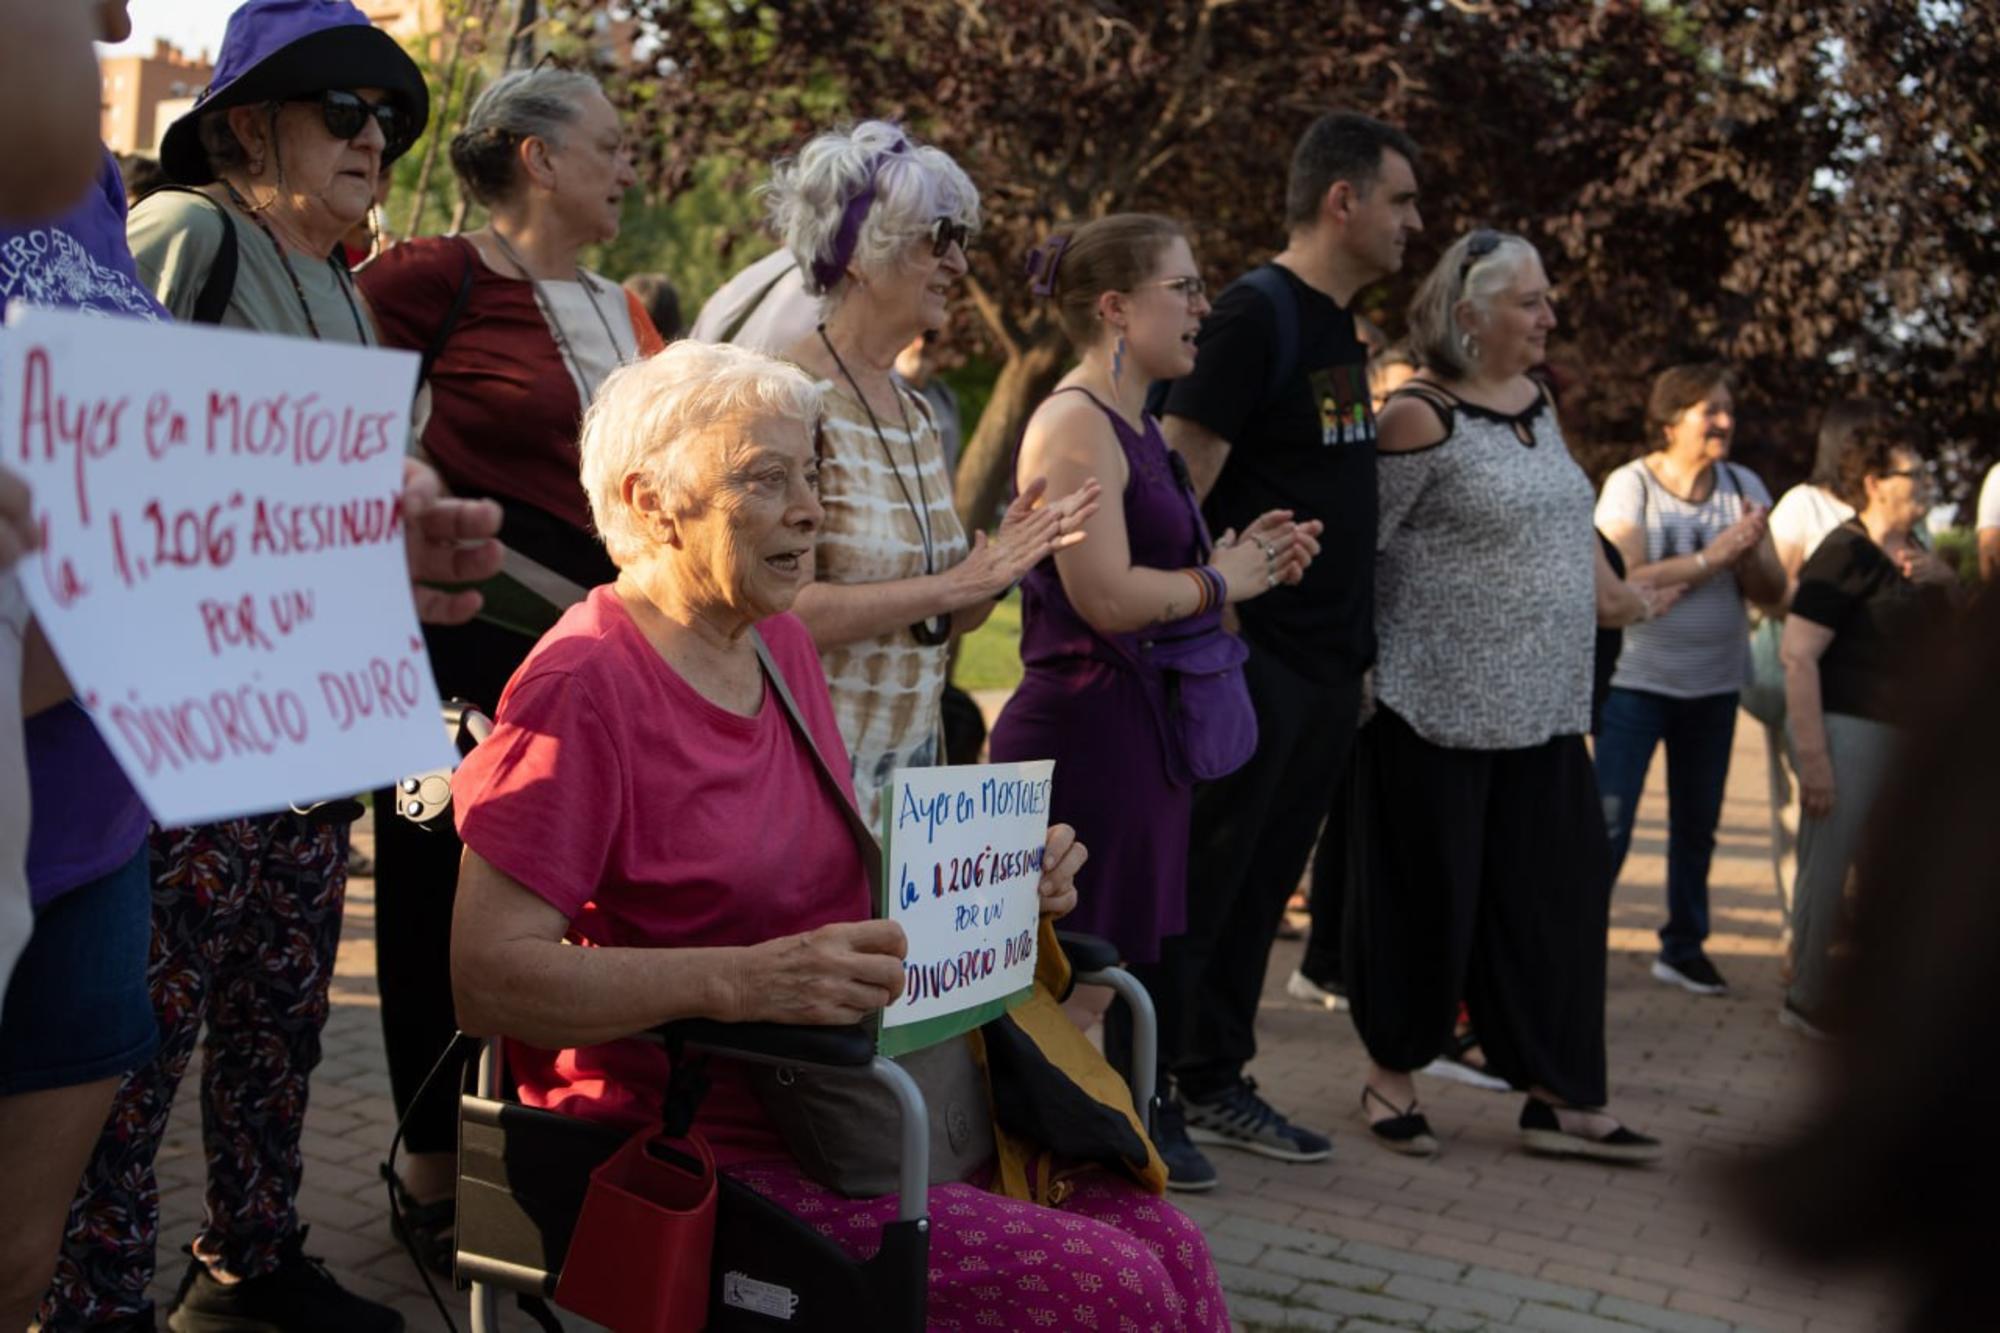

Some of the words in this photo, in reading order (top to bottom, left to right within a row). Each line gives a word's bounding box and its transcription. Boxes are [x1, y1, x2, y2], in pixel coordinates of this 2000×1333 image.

[20, 345, 130, 526] Ayer
[144, 389, 188, 461] en
[205, 389, 397, 466] MOSTOLES
[200, 593, 276, 656] POR
[270, 588, 315, 636] UN
[900, 782, 950, 844] Ayer
[957, 791, 974, 824] en
[982, 778, 1050, 817] MOSTOLES
[901, 862, 920, 910] la
[955, 902, 979, 931] POR
[984, 897, 1004, 925] UN
